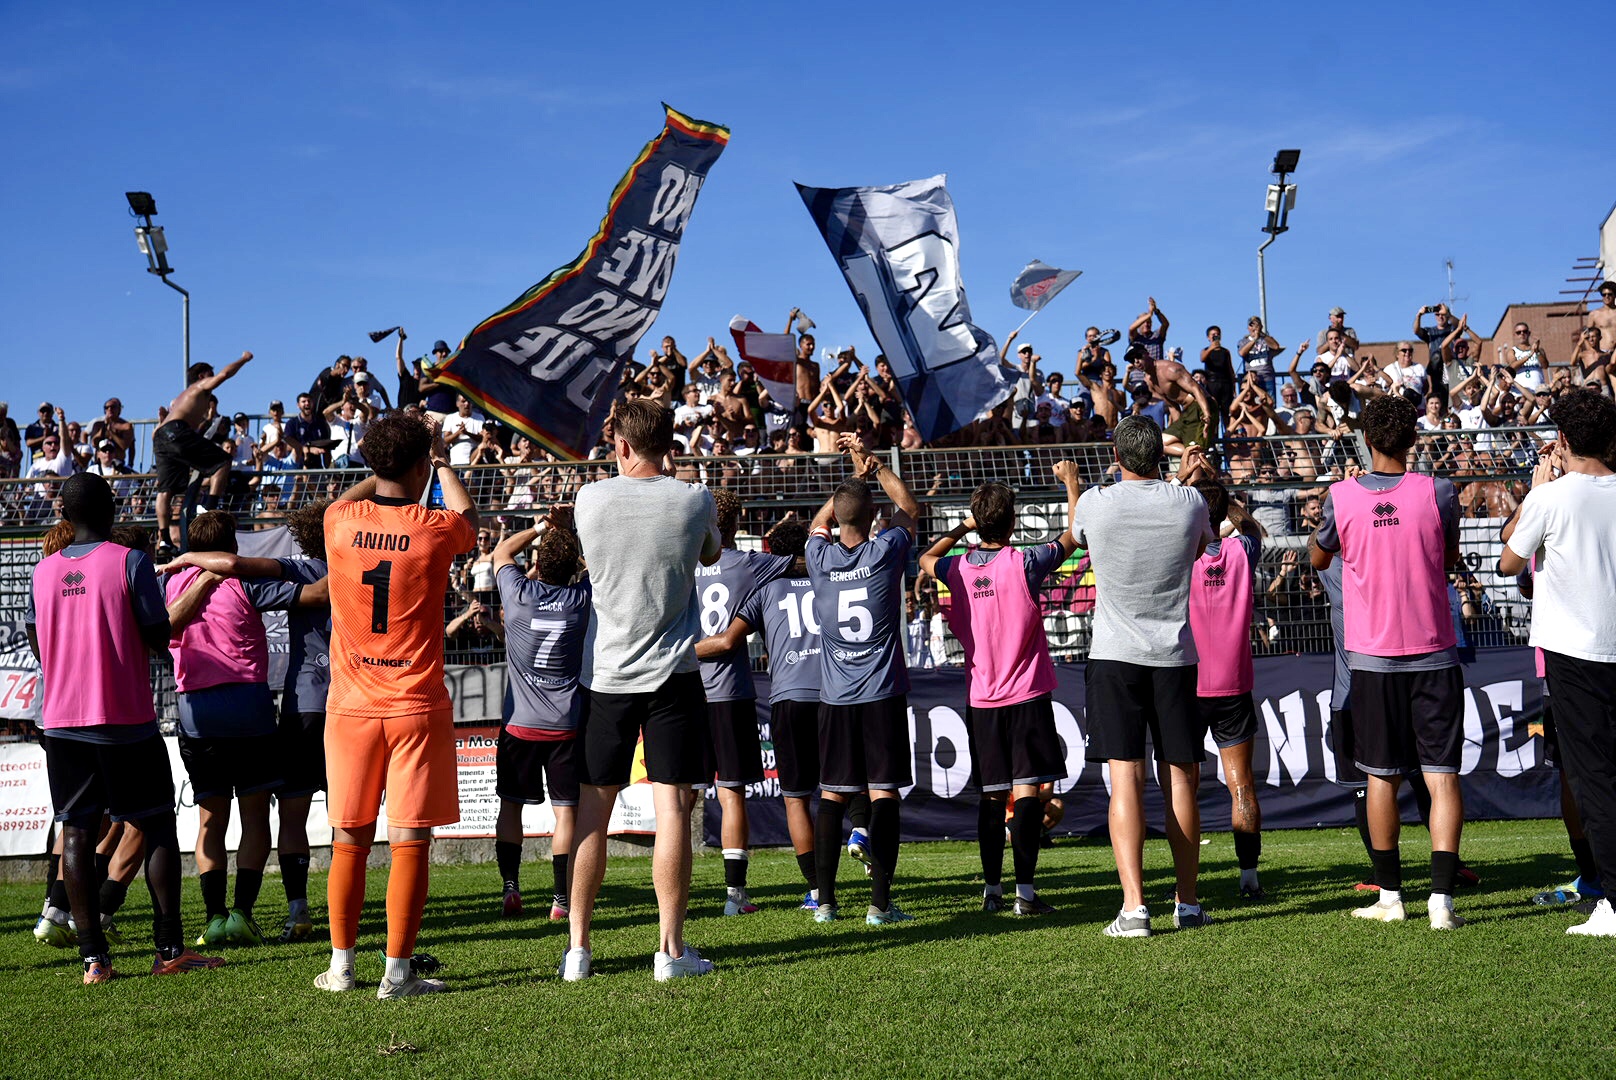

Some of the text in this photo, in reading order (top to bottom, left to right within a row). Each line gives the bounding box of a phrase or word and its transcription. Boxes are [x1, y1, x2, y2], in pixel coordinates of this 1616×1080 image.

[842, 230, 982, 379] 12
[1373, 517, 1400, 528] errea
[351, 530, 411, 552] ANINO
[702, 565, 722, 577] DUCA
[829, 566, 871, 582] BENEDETTO
[62, 586, 86, 597] errea
[1204, 579, 1226, 587] errea
[361, 560, 393, 635] 1
[973, 589, 995, 599] errea
[696, 582, 730, 637] 8
[778, 590, 821, 639] 10
[837, 587, 874, 642] 5
[530, 618, 567, 668] 7
[799, 648, 821, 657] KLIN
[362, 656, 413, 668] KLINGER
[1, 673, 38, 710] 74
